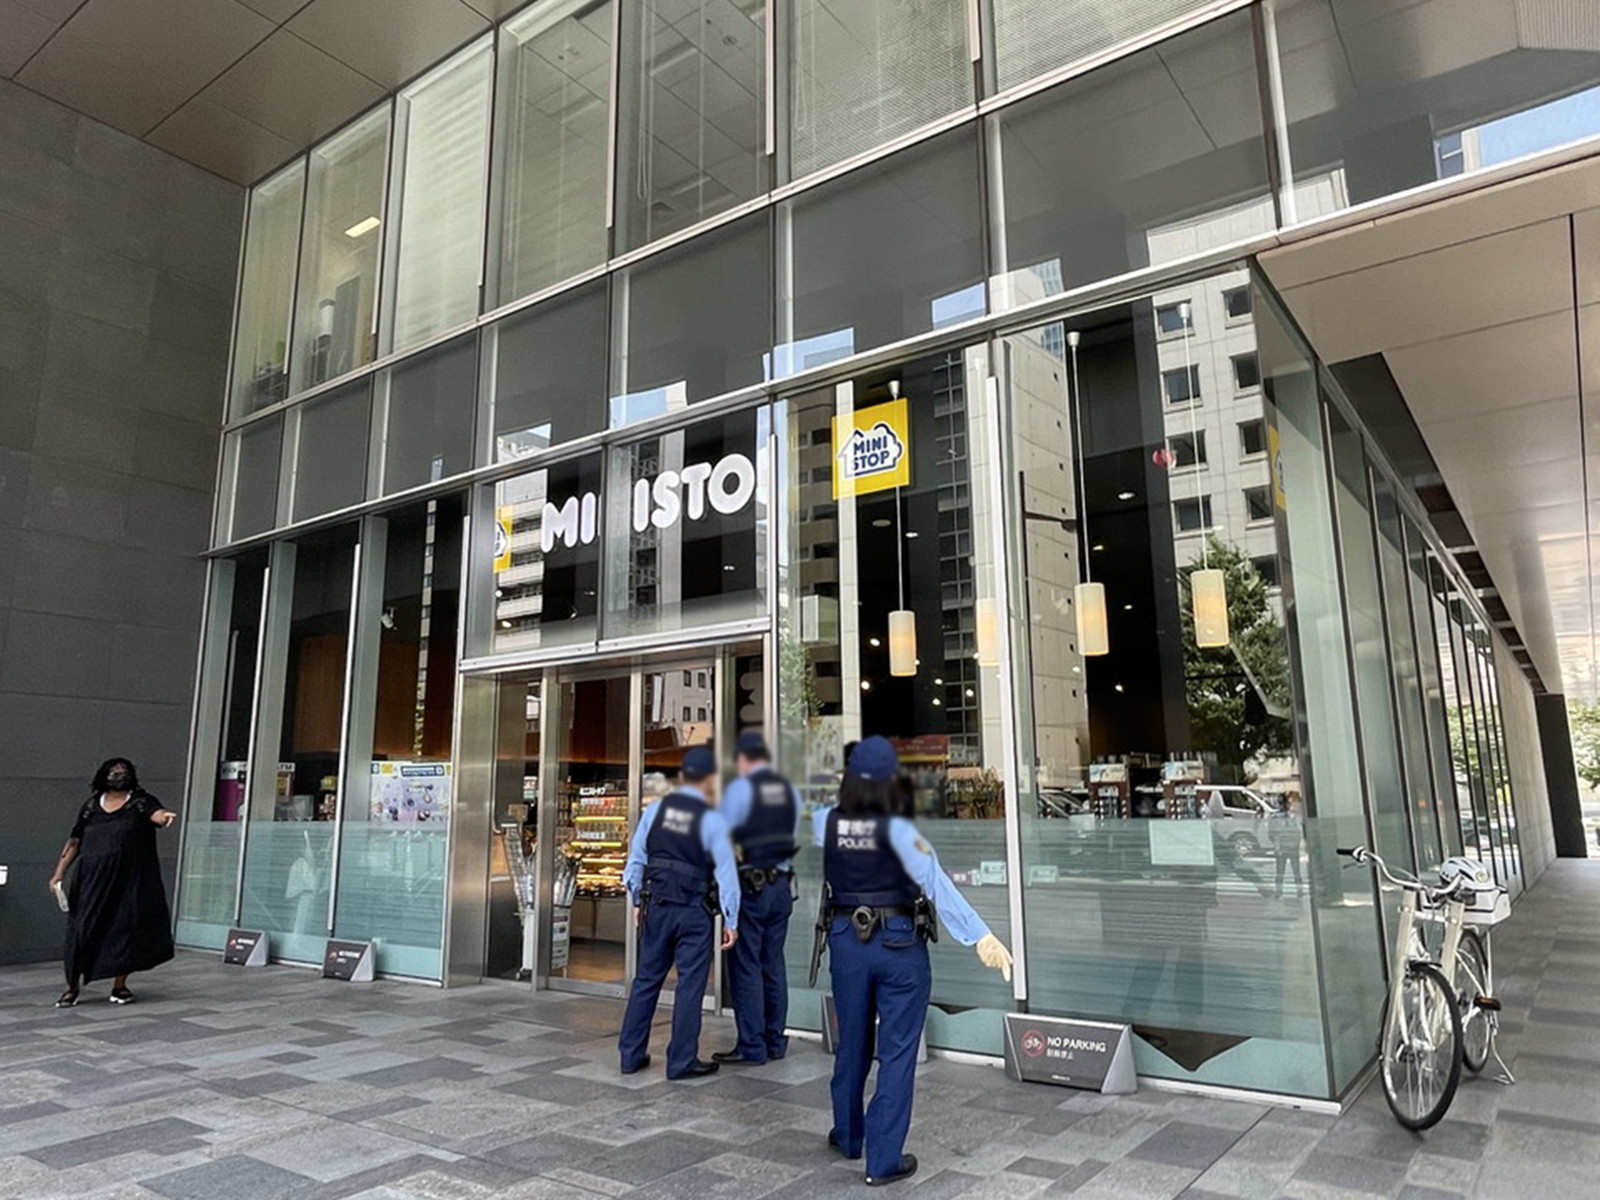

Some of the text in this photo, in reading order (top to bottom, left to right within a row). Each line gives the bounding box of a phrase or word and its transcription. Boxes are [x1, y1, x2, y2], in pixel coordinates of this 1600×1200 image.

[853, 435, 888, 455] MINI
[851, 450, 891, 471] STOP
[837, 836, 877, 850] POLICE
[1047, 1036, 1107, 1053] NO PARKING
